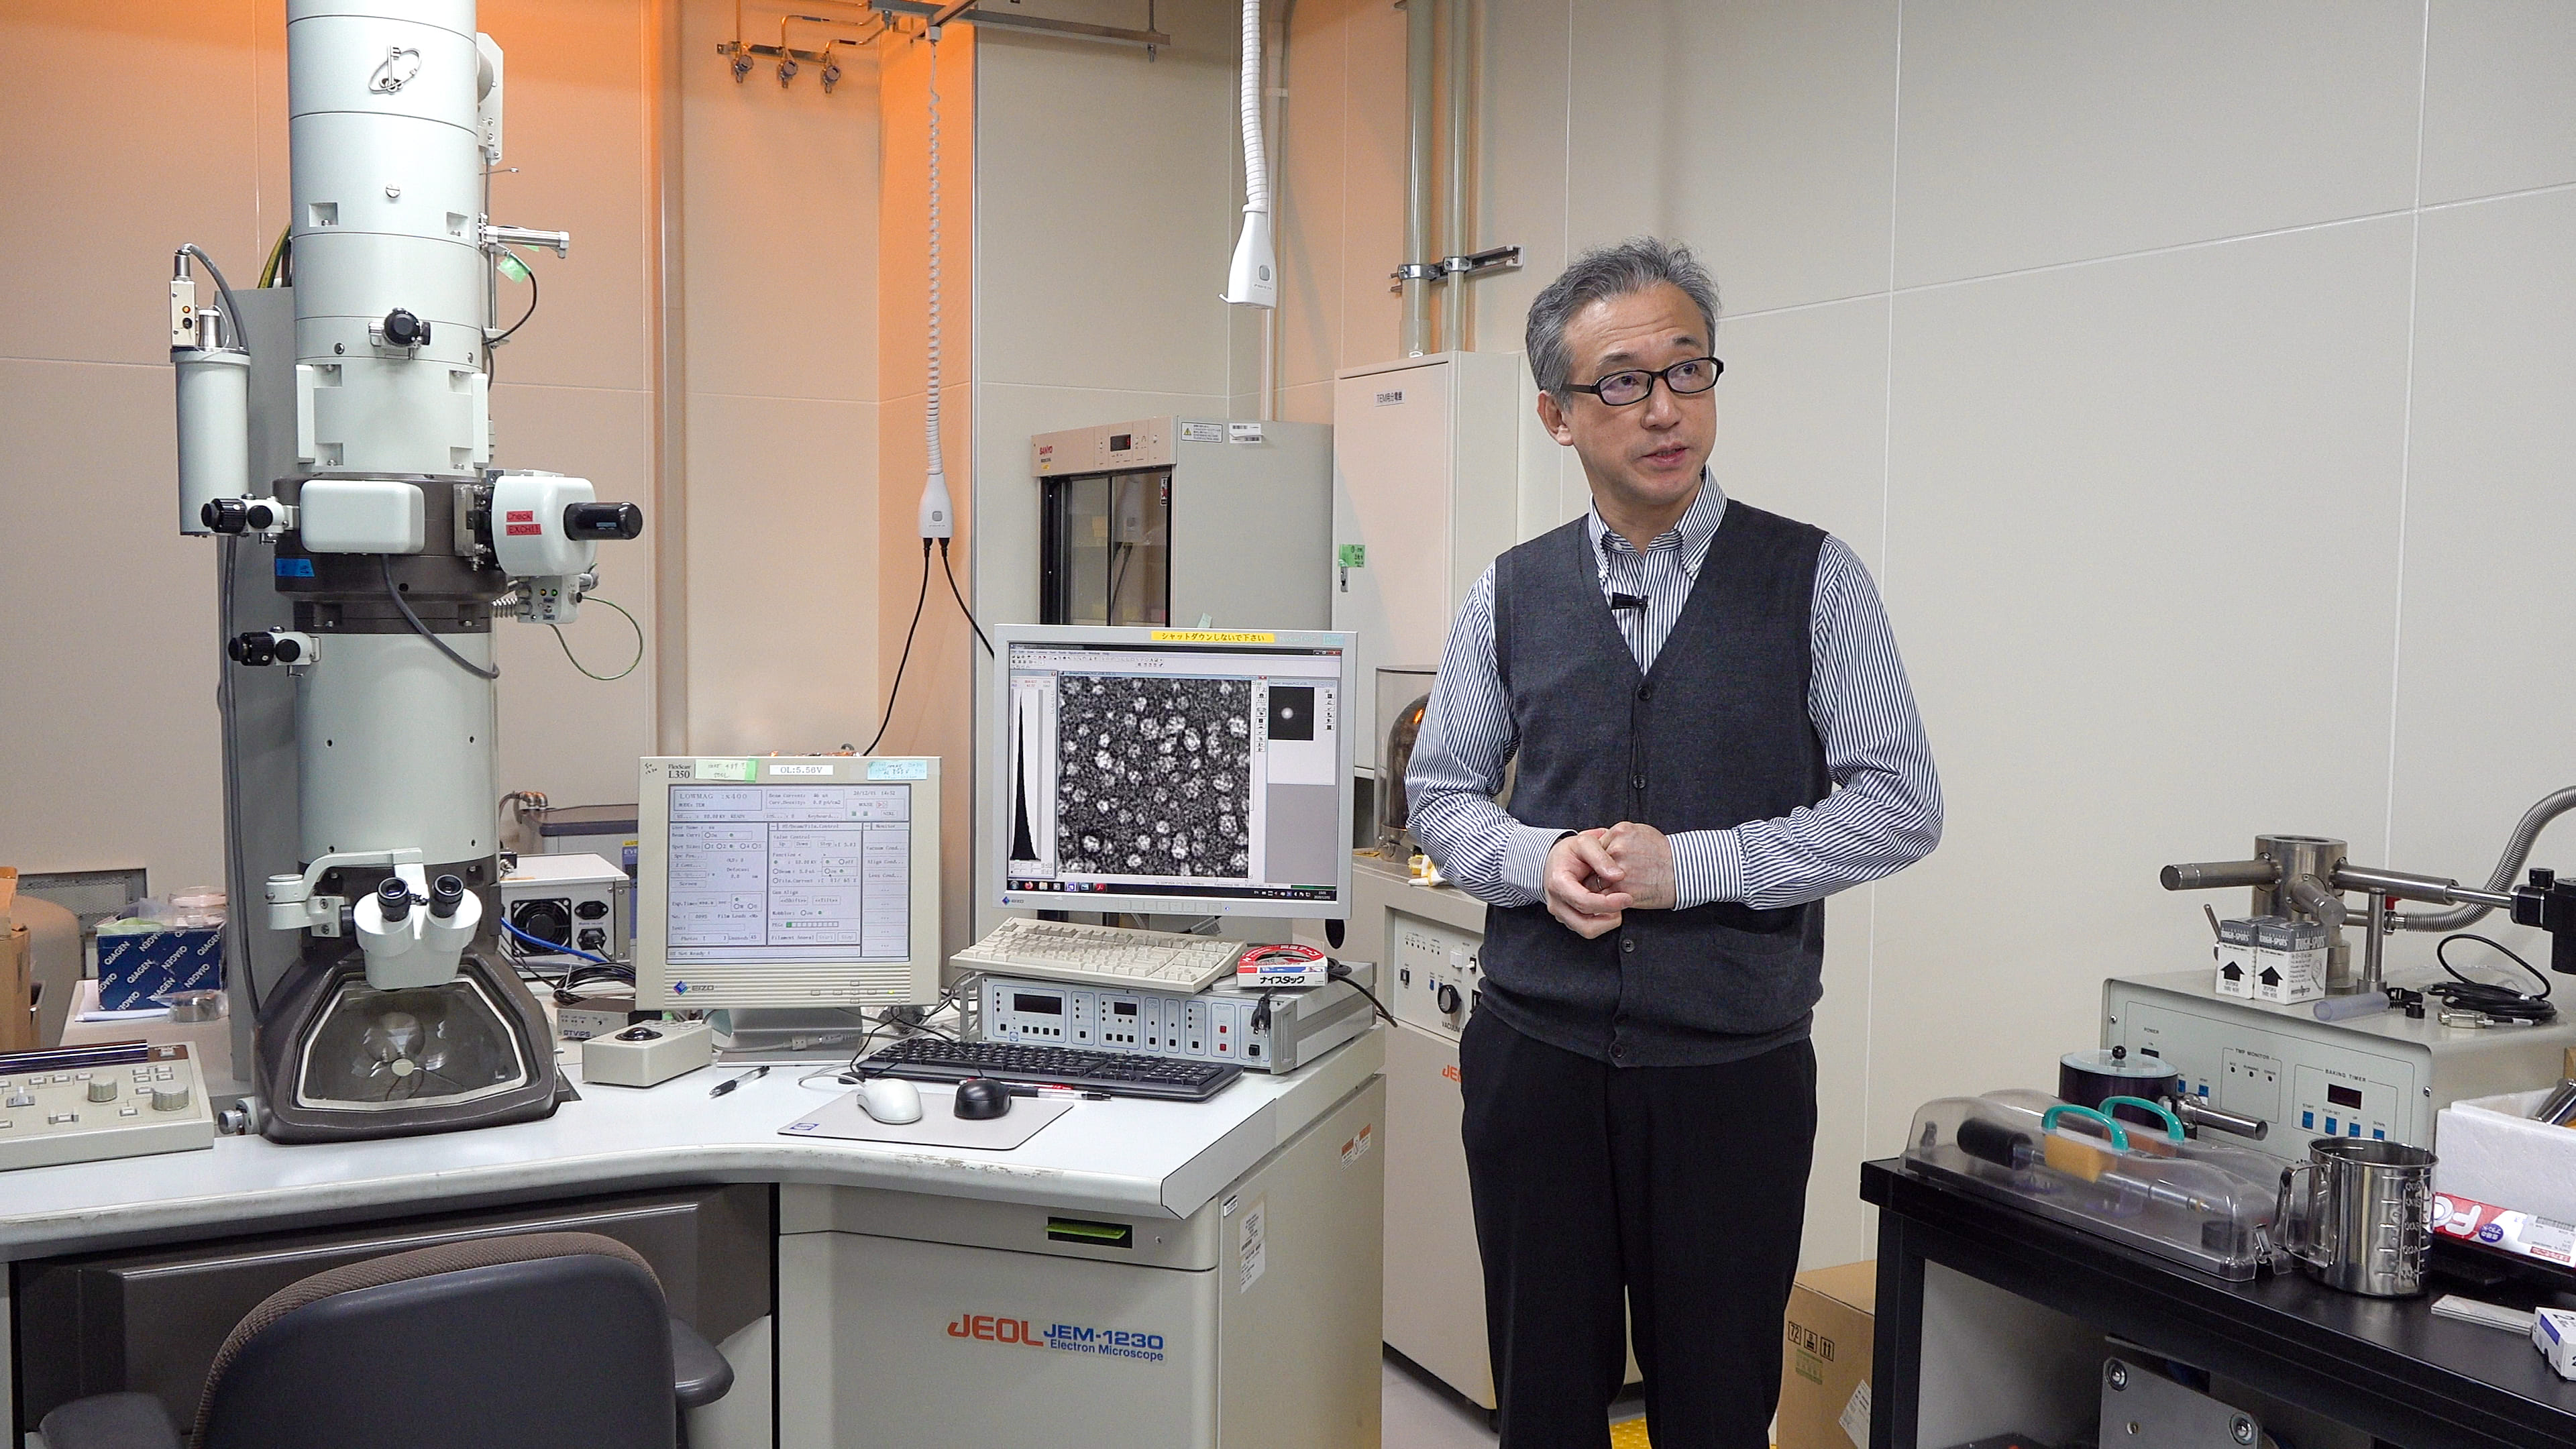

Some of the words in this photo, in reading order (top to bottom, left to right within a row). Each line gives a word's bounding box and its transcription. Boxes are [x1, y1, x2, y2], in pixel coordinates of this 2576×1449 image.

[508, 513, 531, 521] Check
[1161, 633, 1265, 642] シャットダウンしないで下さい
[668, 771, 690, 779] L350
[2221, 930, 2251, 942] TOUGH-SPOTS
[2259, 934, 2288, 947] TOUGH-SPOTS
[104, 941, 131, 965] QIAGEN
[161, 946, 188, 970] QIAGEN
[126, 959, 153, 983] QIAGEN
[183, 963, 210, 988] QIAGEN
[1260, 976, 1305, 984] ナイスタック
[2247, 1051, 2270, 1060] MONITOR
[2325, 1069, 2347, 1078] BAKING
[2349, 1074, 2367, 1082] TIMER
[947, 1314, 1044, 1348] JEOL
[1043, 1324, 1165, 1350] JEM-1230
[1790, 1324, 1799, 1339] 72
[1050, 1340, 1095, 1354] Electron
[1099, 1344, 1164, 1362] Microscope
